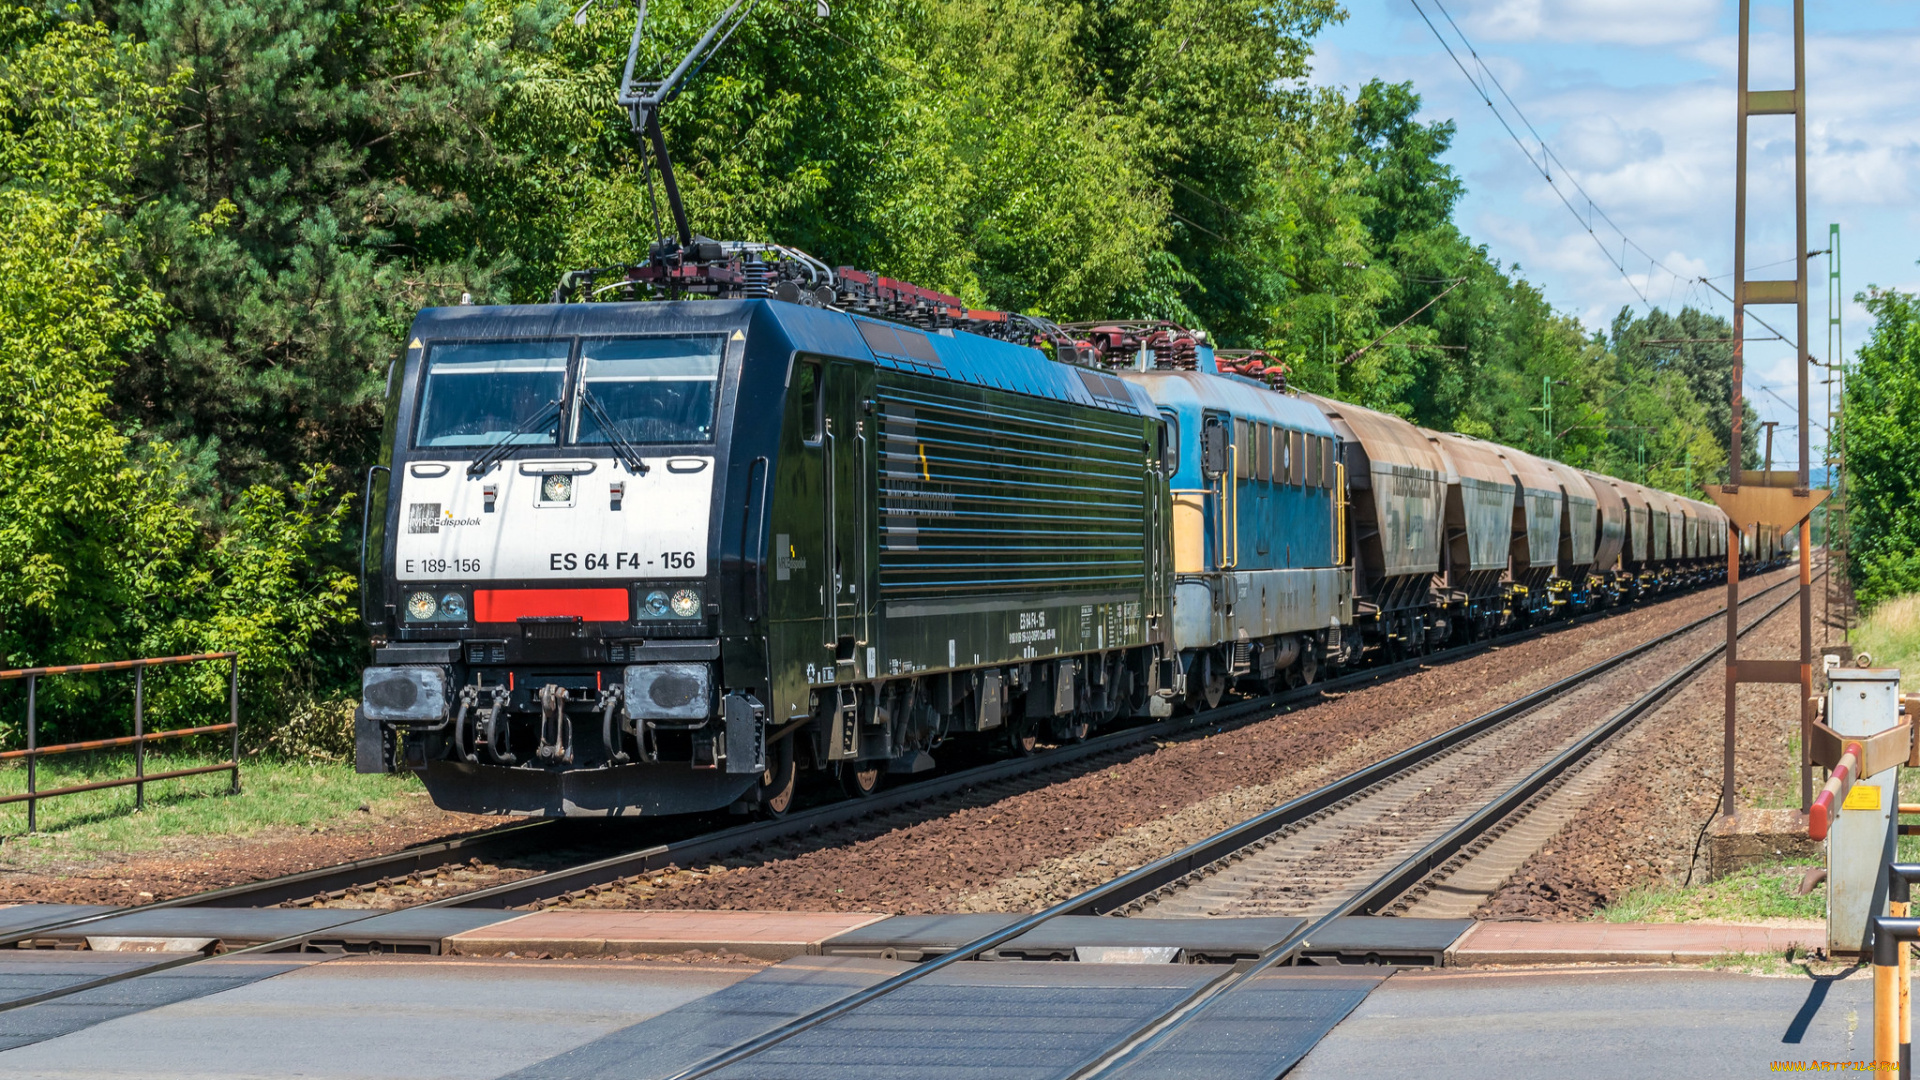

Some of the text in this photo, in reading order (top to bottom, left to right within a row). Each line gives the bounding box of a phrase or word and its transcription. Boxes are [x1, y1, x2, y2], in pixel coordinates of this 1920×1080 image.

[405, 558, 481, 573] E 189-156
[550, 552, 578, 571] ES
[584, 552, 609, 570] 64
[616, 551, 640, 570] F4
[660, 551, 696, 569] 156
